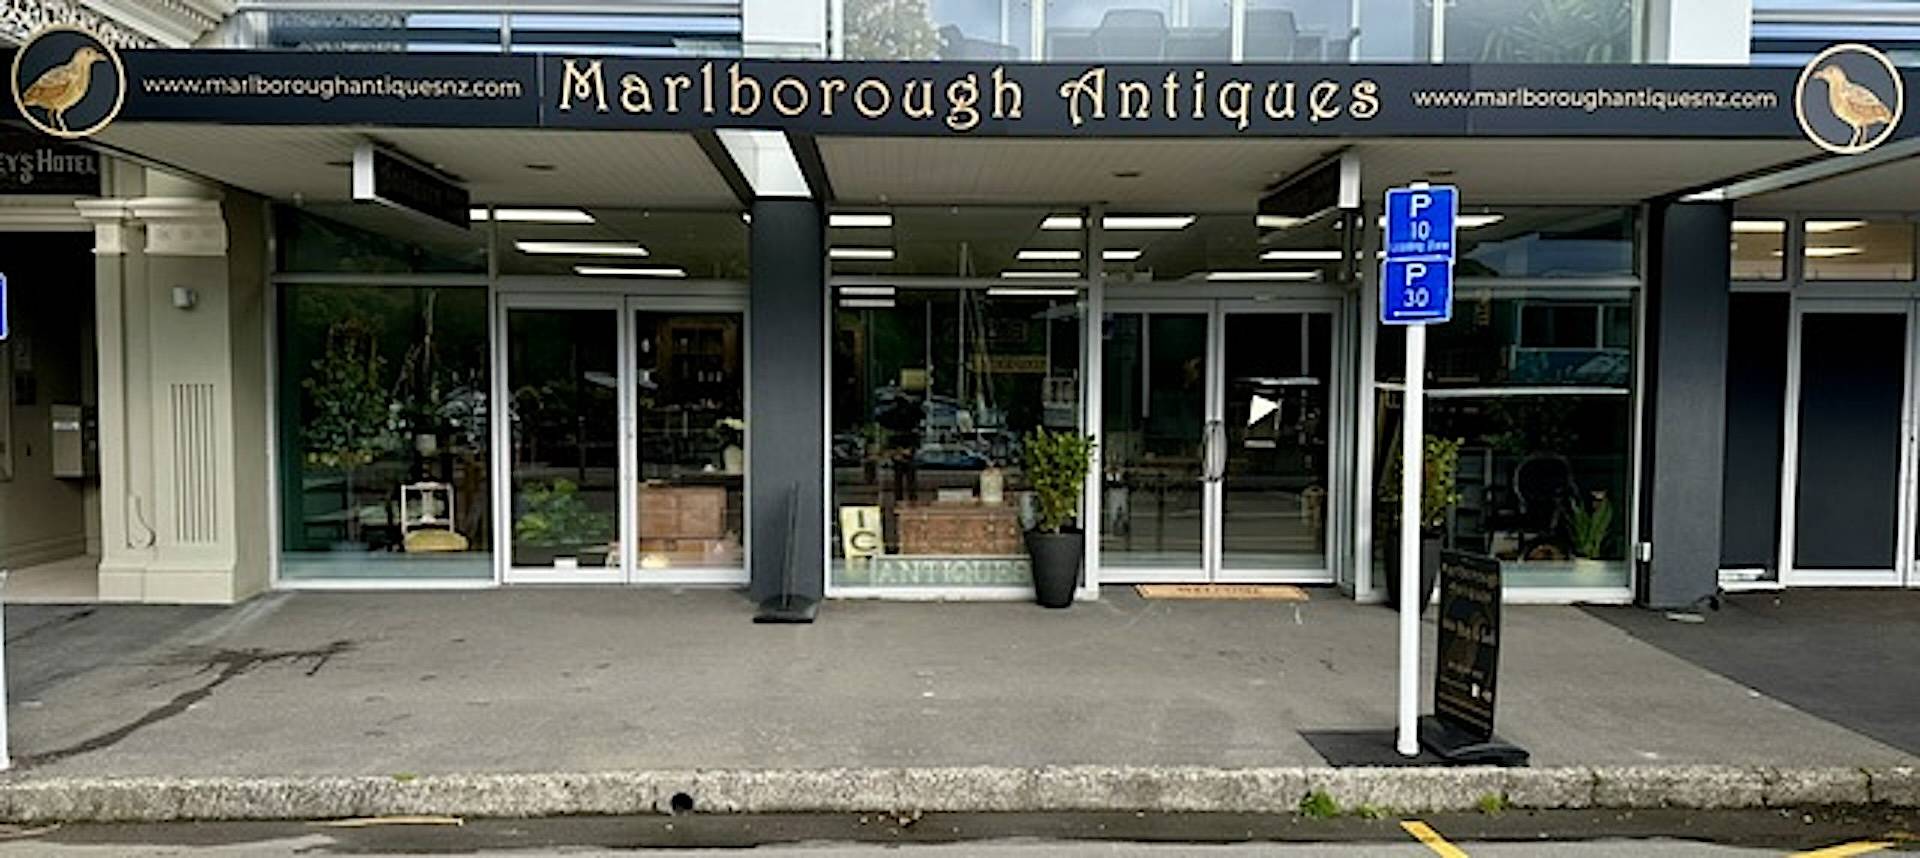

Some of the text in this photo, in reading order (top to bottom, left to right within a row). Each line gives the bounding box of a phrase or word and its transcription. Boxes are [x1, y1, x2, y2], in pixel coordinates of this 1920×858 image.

[143, 74, 522, 102] www.marlboroughantiquesnz.com
[558, 60, 1383, 132] Marlborough Antiques
[1412, 86, 1778, 112] www.marlboroughantiquesnz.com
[1410, 194, 1432, 218] P
[1411, 221, 1431, 240] 10
[1405, 263, 1427, 286] P
[1403, 288, 1429, 307] 30
[877, 560, 1031, 584] ANTIQUES
